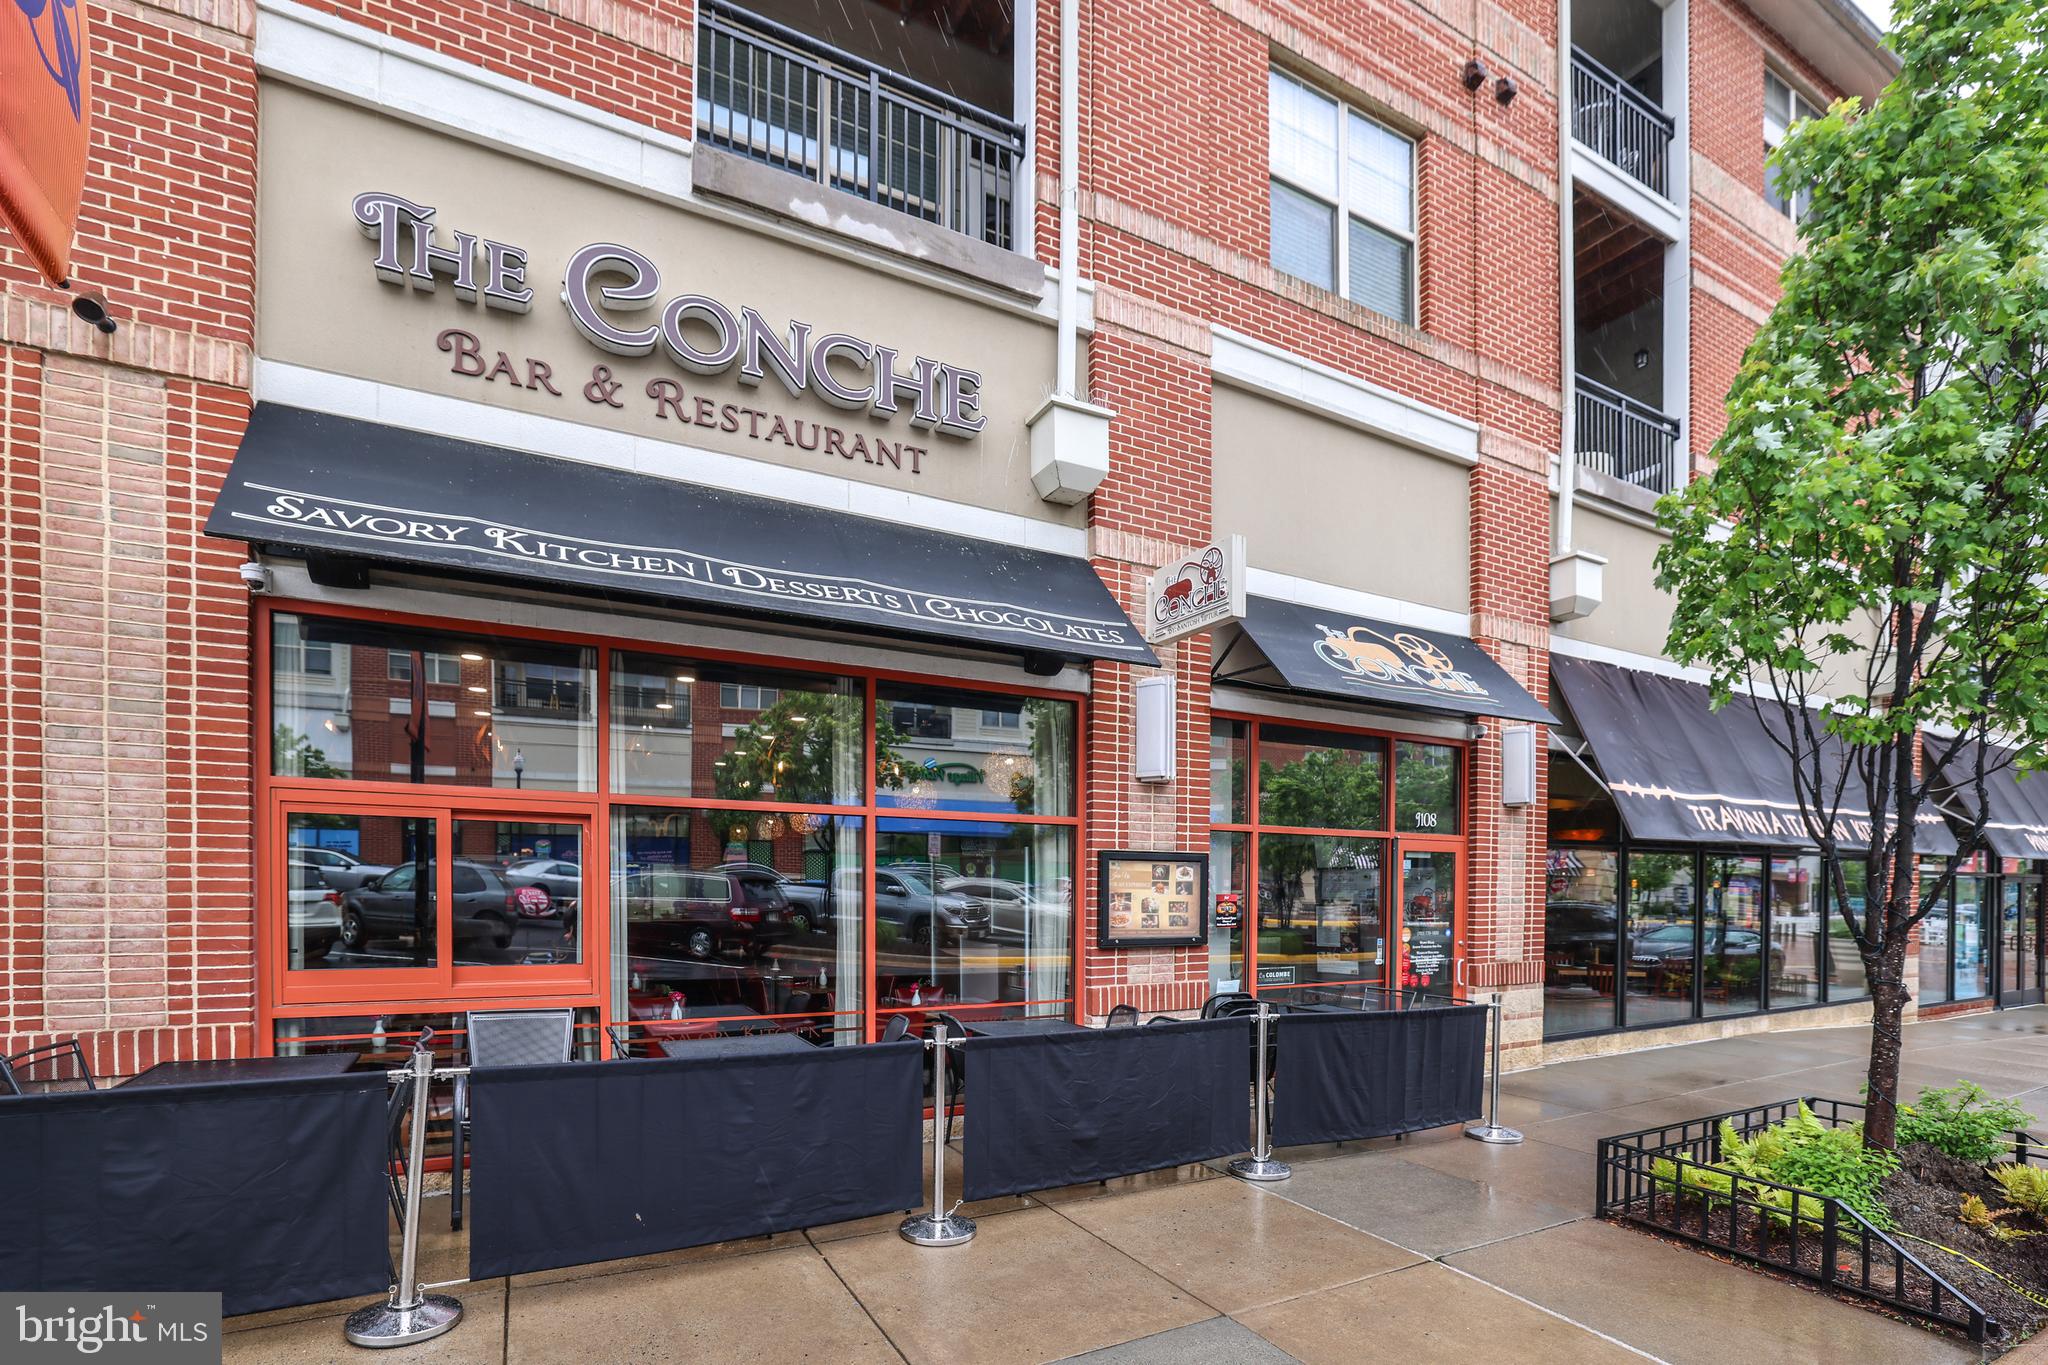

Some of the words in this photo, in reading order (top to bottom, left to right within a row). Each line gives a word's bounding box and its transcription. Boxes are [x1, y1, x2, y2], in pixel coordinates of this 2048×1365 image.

[352, 192, 534, 312] THE
[563, 242, 988, 438] CONCHE
[437, 329, 562, 396] BAR
[583, 364, 623, 408] &
[646, 377, 928, 473] RESTAURANT
[266, 495, 470, 542] SAVORY
[484, 527, 696, 578] KITCHEN
[722, 566, 901, 609] DESSERTS
[925, 599, 1125, 644] CHOCOLATES
[1155, 577, 1229, 624] CONCHE
[1313, 640, 1489, 696] CONCHE
[1415, 812, 1437, 828] 9108
[1687, 804, 1789, 835] TRAVINIA
